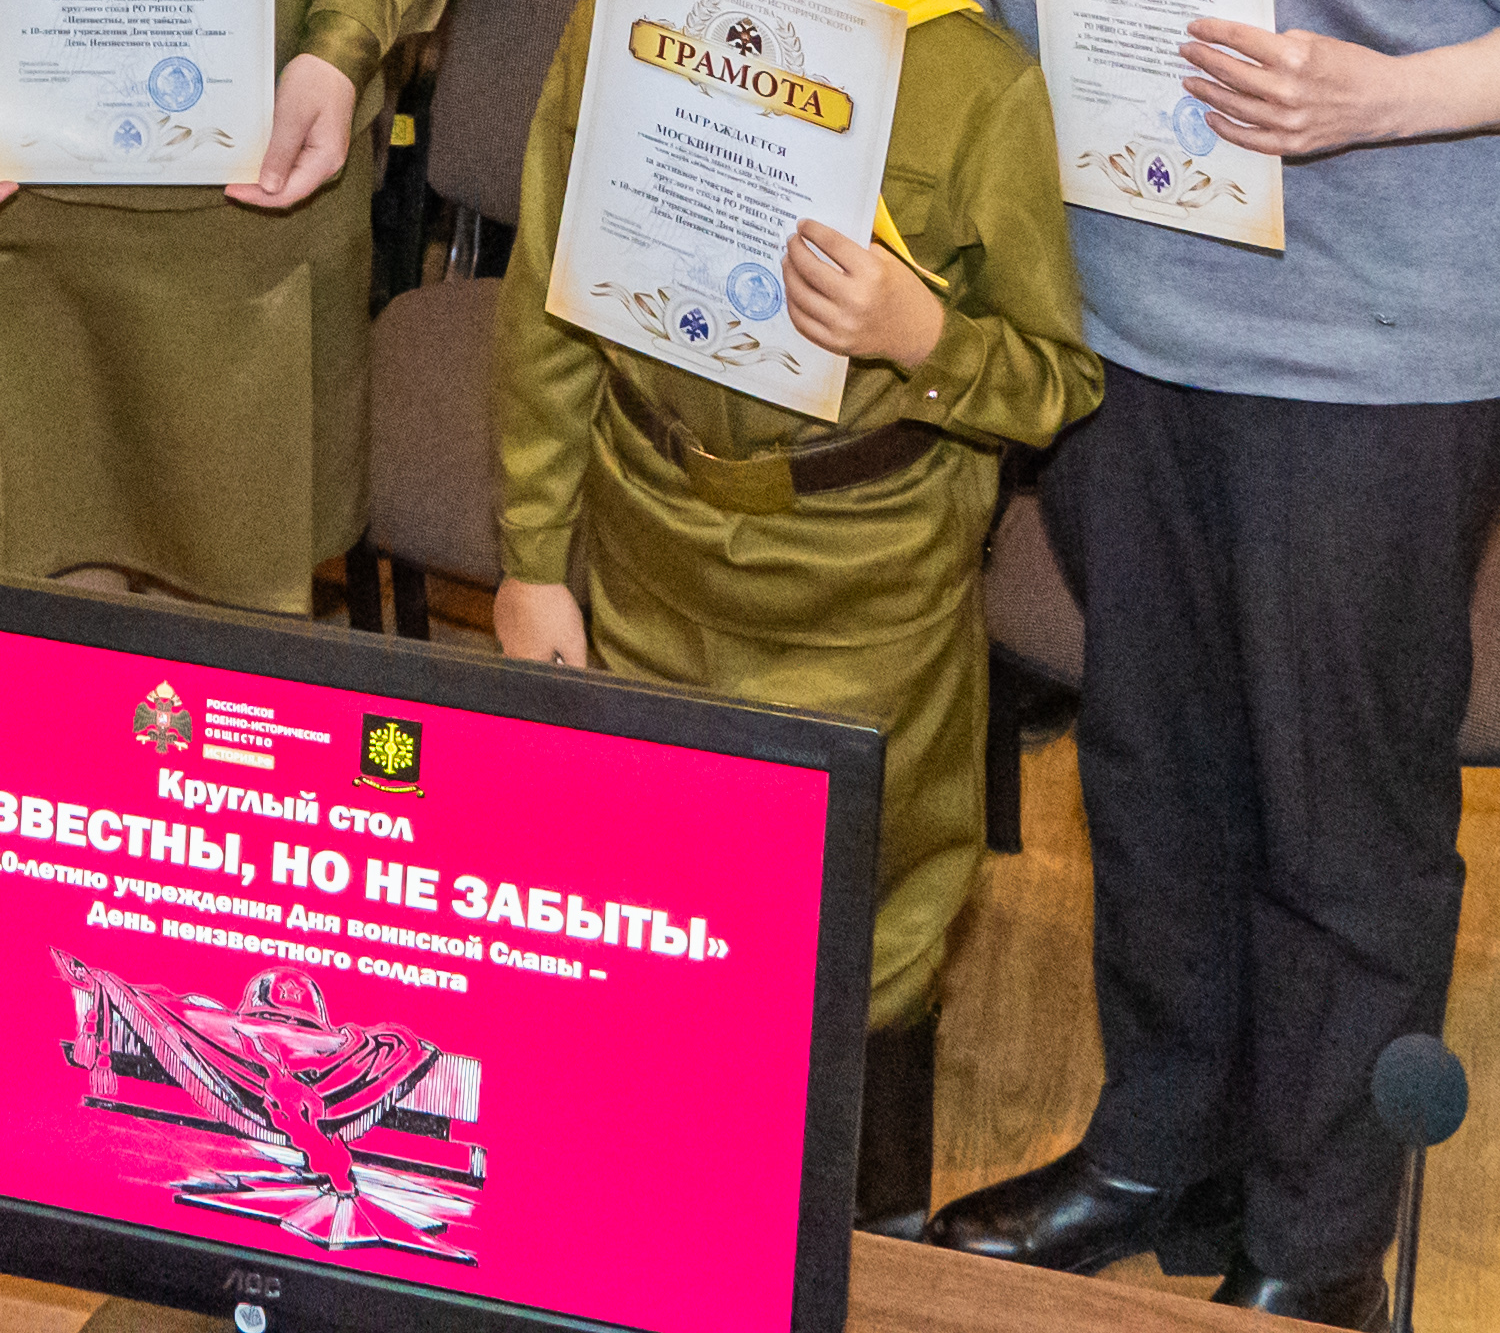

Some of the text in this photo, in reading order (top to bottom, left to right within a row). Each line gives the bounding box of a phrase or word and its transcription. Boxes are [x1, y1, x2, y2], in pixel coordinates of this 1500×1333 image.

[132, 5, 146, 13] РО
[655, 33, 825, 119] ГРАМОТА
[655, 123, 743, 165] МОСКВИТИН
[746, 156, 799, 187] ВАДИМ,
[675, 107, 787, 157] НАГРАЖДАЕТСЯ
[723, 196, 737, 209] РО
[769, 215, 784, 227] СК
[205, 713, 331, 744] ВОЕННО-ИСТОРИЧЕСКОЕ
[206, 698, 274, 719] РОССИЙСКОЕ
[204, 727, 273, 748] ОБЩЕСТВО
[204, 747, 272, 768] ИСТОРИЯ.РФ
[158, 768, 415, 842] Круглый стол
[113, 872, 283, 924] учреждения
[286, 903, 341, 936] Дня
[346, 917, 483, 962] воинской
[488, 940, 582, 980] Славы
[271, 841, 350, 894] НО
[364, 859, 440, 912] НЕ
[452, 875, 730, 962] ЗАБЫТЫ»
[87, 900, 468, 994] День неизвестного солдата
